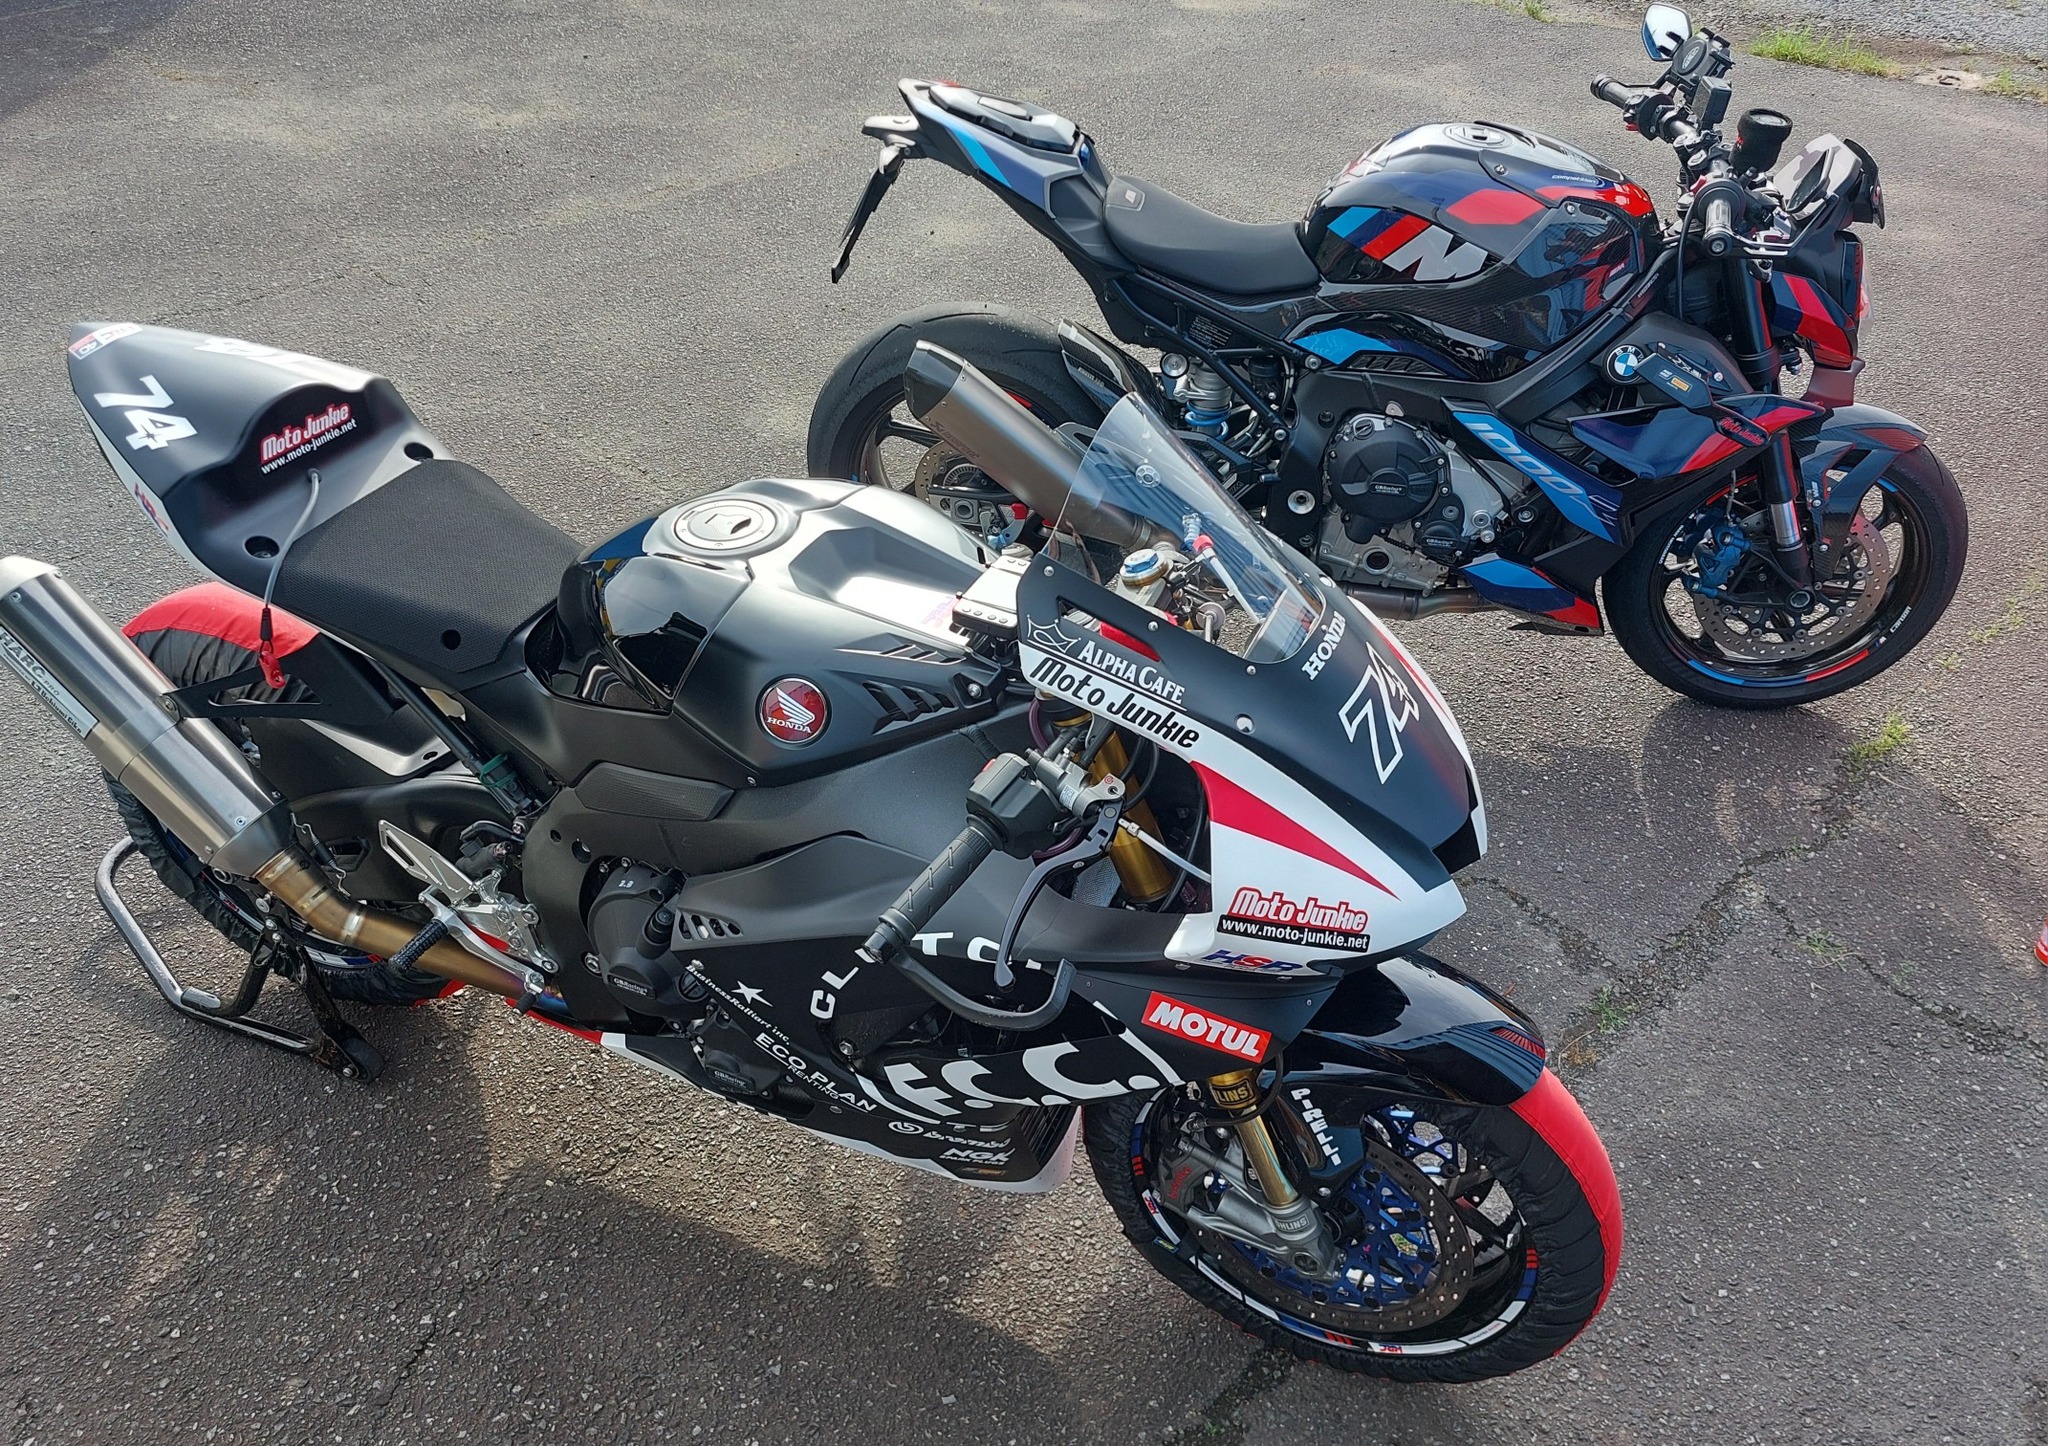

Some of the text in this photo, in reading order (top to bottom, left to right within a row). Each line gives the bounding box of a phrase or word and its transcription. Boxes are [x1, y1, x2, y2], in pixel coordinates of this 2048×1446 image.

[93, 374, 198, 450] 74
[262, 405, 349, 461] Moto Junkie
[261, 418, 358, 474] www.moto-junkie.net
[1077, 640, 1185, 705] ALPHA CAFE
[767, 716, 812, 733] HONDA
[1029, 656, 1200, 748] Moto Junkie
[1221, 918, 1369, 950] www.moto-junkie.net
[1231, 887, 1368, 932] Moto Junkie
[771, 1026, 790, 1046] inc.
[1148, 1000, 1261, 1057] MOTUL
[755, 1032, 878, 1112] ECO PLAN
[787, 1064, 839, 1100] RENTING
[940, 1147, 1016, 1161] NGK
[1290, 1087, 1342, 1166] PIRELLI
